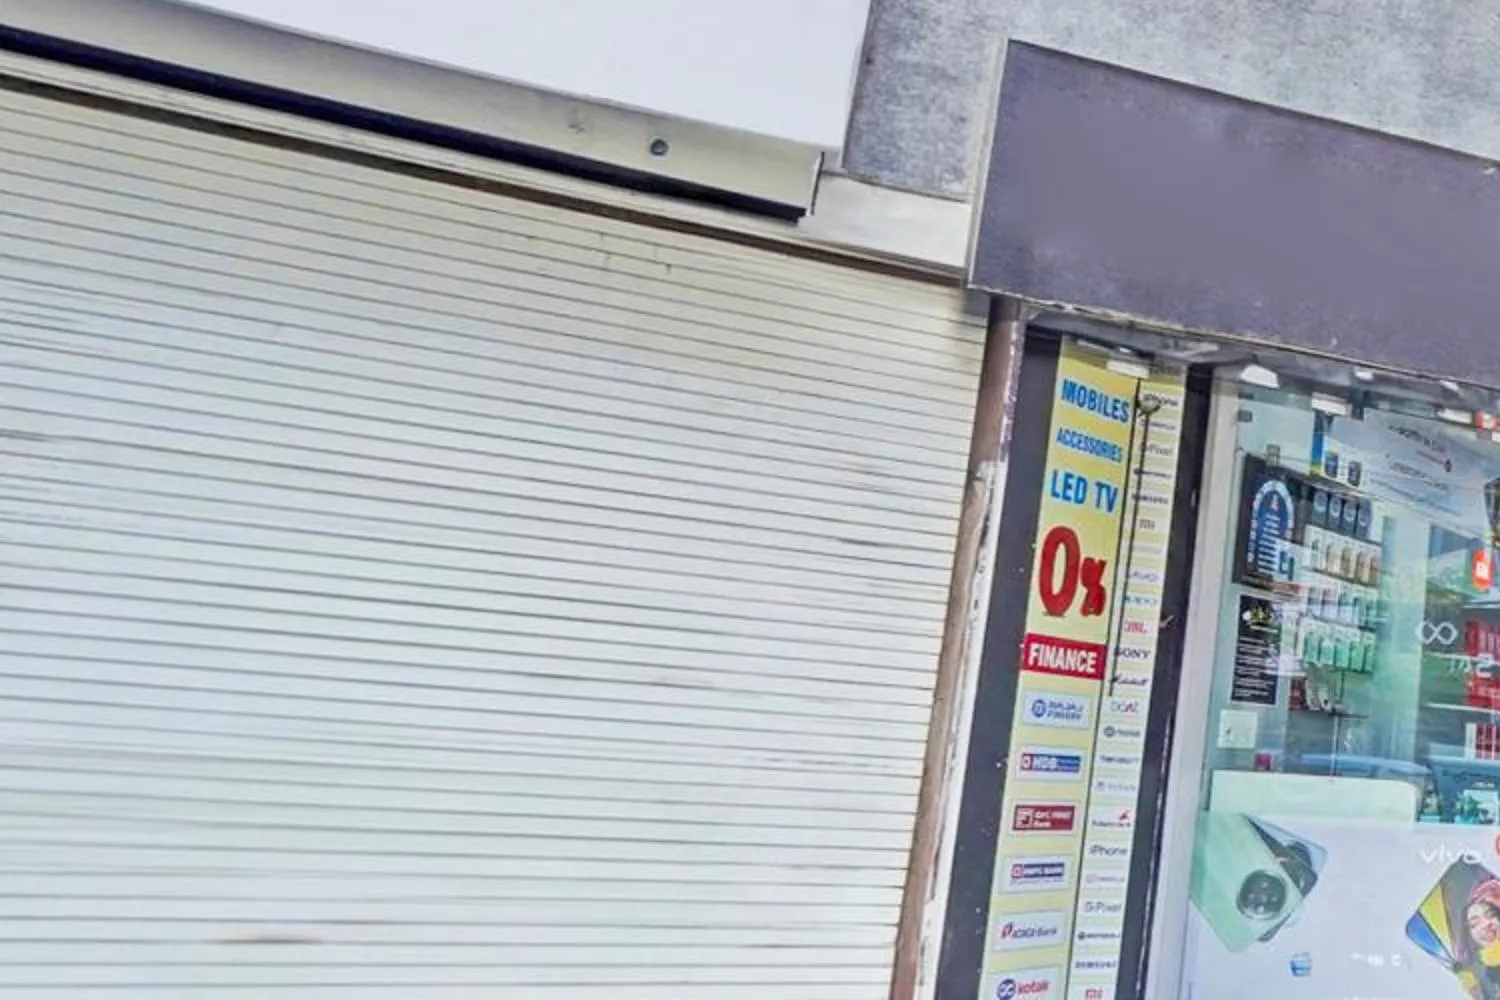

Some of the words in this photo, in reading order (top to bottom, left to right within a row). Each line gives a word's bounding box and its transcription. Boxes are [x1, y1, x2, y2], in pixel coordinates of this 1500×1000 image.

[1060, 379, 1131, 424] MOBILES
[1055, 427, 1123, 464] ACCESSORIES
[1050, 467, 1088, 505] LED
[1095, 480, 1118, 513] TV
[1038, 525, 1107, 618] 0%
[1028, 641, 1098, 674] FINANCE
